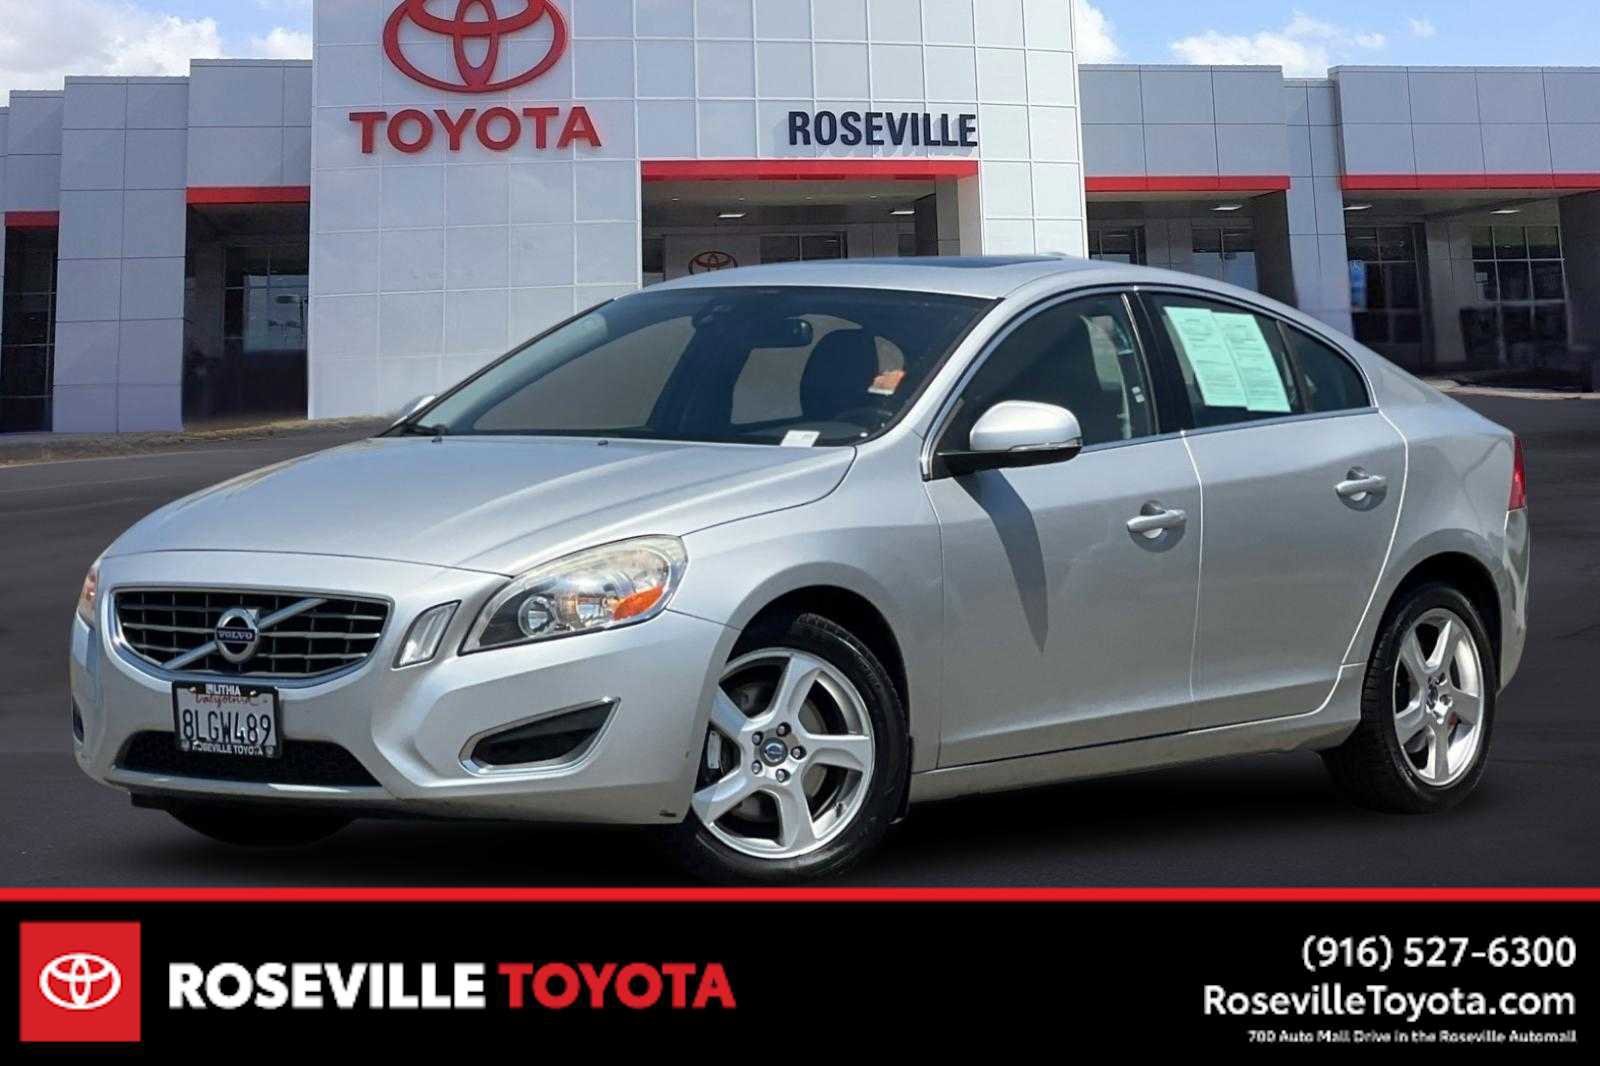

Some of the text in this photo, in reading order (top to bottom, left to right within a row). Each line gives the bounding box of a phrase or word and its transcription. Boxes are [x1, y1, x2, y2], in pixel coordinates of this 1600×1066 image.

[349, 106, 602, 154] TOYOTA
[788, 110, 978, 147] ROSEVILLE
[218, 630, 253, 640] VOLVO
[182, 708, 272, 745] 8LGW489
